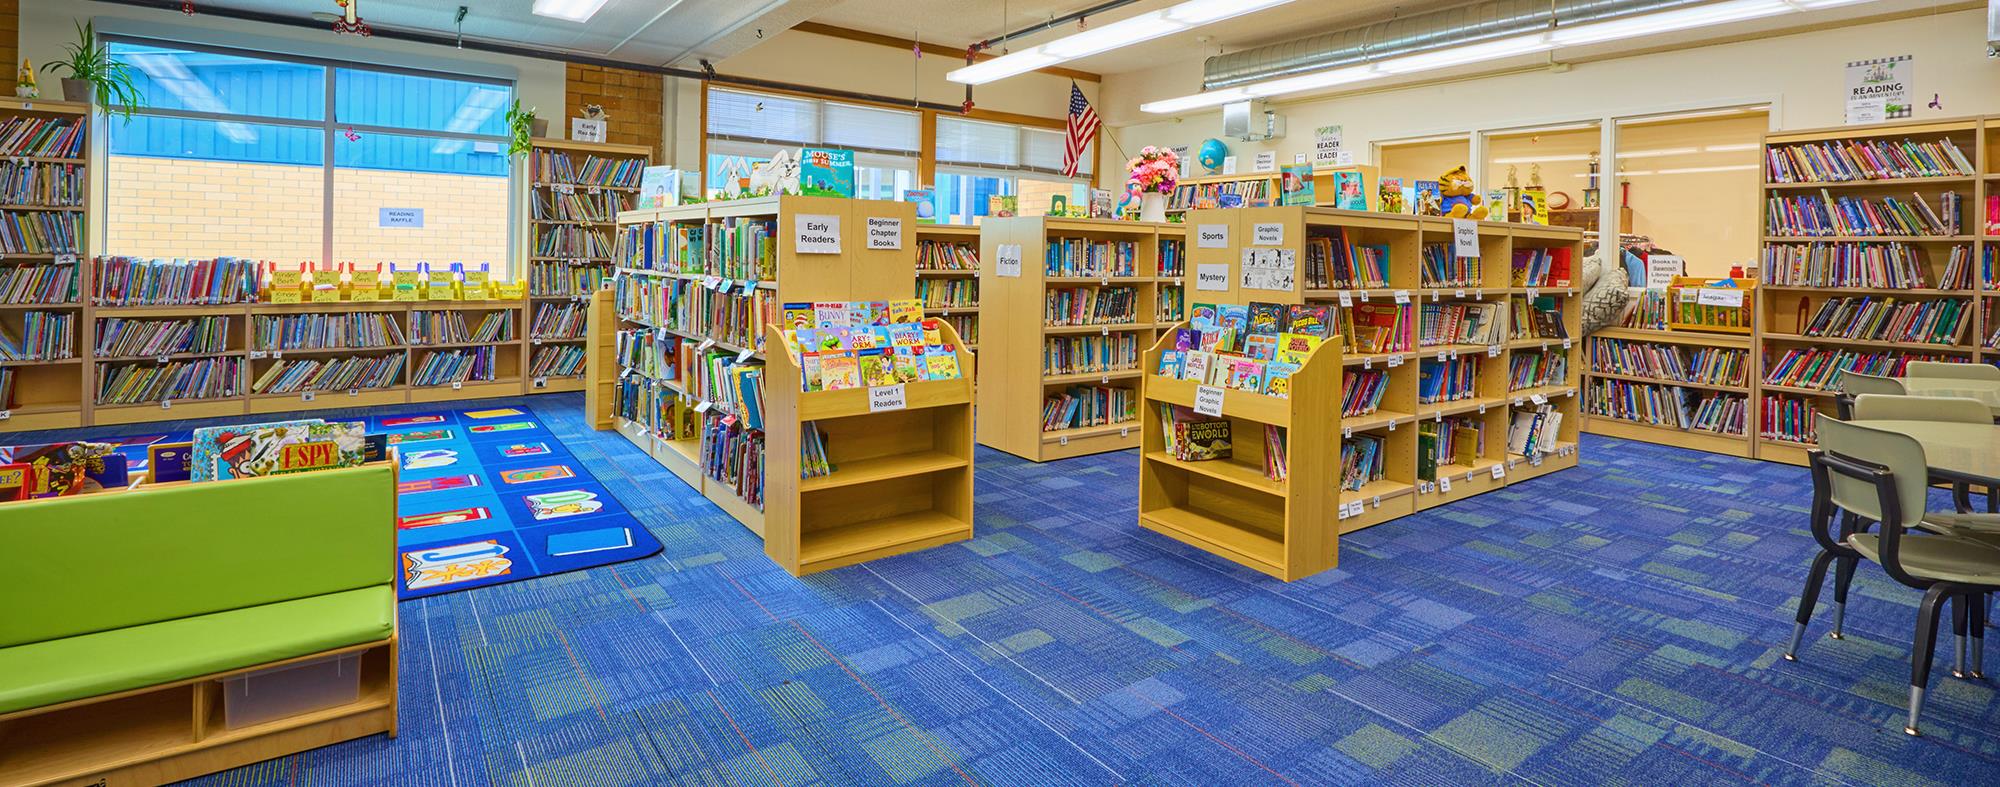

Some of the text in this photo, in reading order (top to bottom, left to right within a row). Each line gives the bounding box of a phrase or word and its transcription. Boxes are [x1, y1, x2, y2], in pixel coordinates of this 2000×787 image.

[1853, 83, 1903, 95] READING
[1317, 141, 1339, 149] READER
[804, 150, 846, 161] MOUSE'S
[819, 158, 853, 167] SUMMER
[807, 222, 829, 232] Early
[868, 219, 899, 228] Beginner
[871, 229, 897, 237] Chapter
[1202, 232, 1224, 240] Sports
[801, 234, 836, 243] Readers
[1000, 257, 1019, 265] Fiction
[1200, 273, 1225, 283] Mystery
[818, 310, 846, 321] BUNNY
[894, 331, 913, 339] DIARY
[875, 389, 894, 397] Level
[1200, 387, 1222, 396] Beginner
[874, 399, 902, 408] Readers
[1199, 396, 1219, 406] Graphic
[1199, 405, 1217, 414] Novels
[1200, 421, 1228, 429] BOTTOM
[1196, 428, 1229, 439] WORLD
[284, 443, 333, 468] I SPY
[422, 545, 504, 562] J
